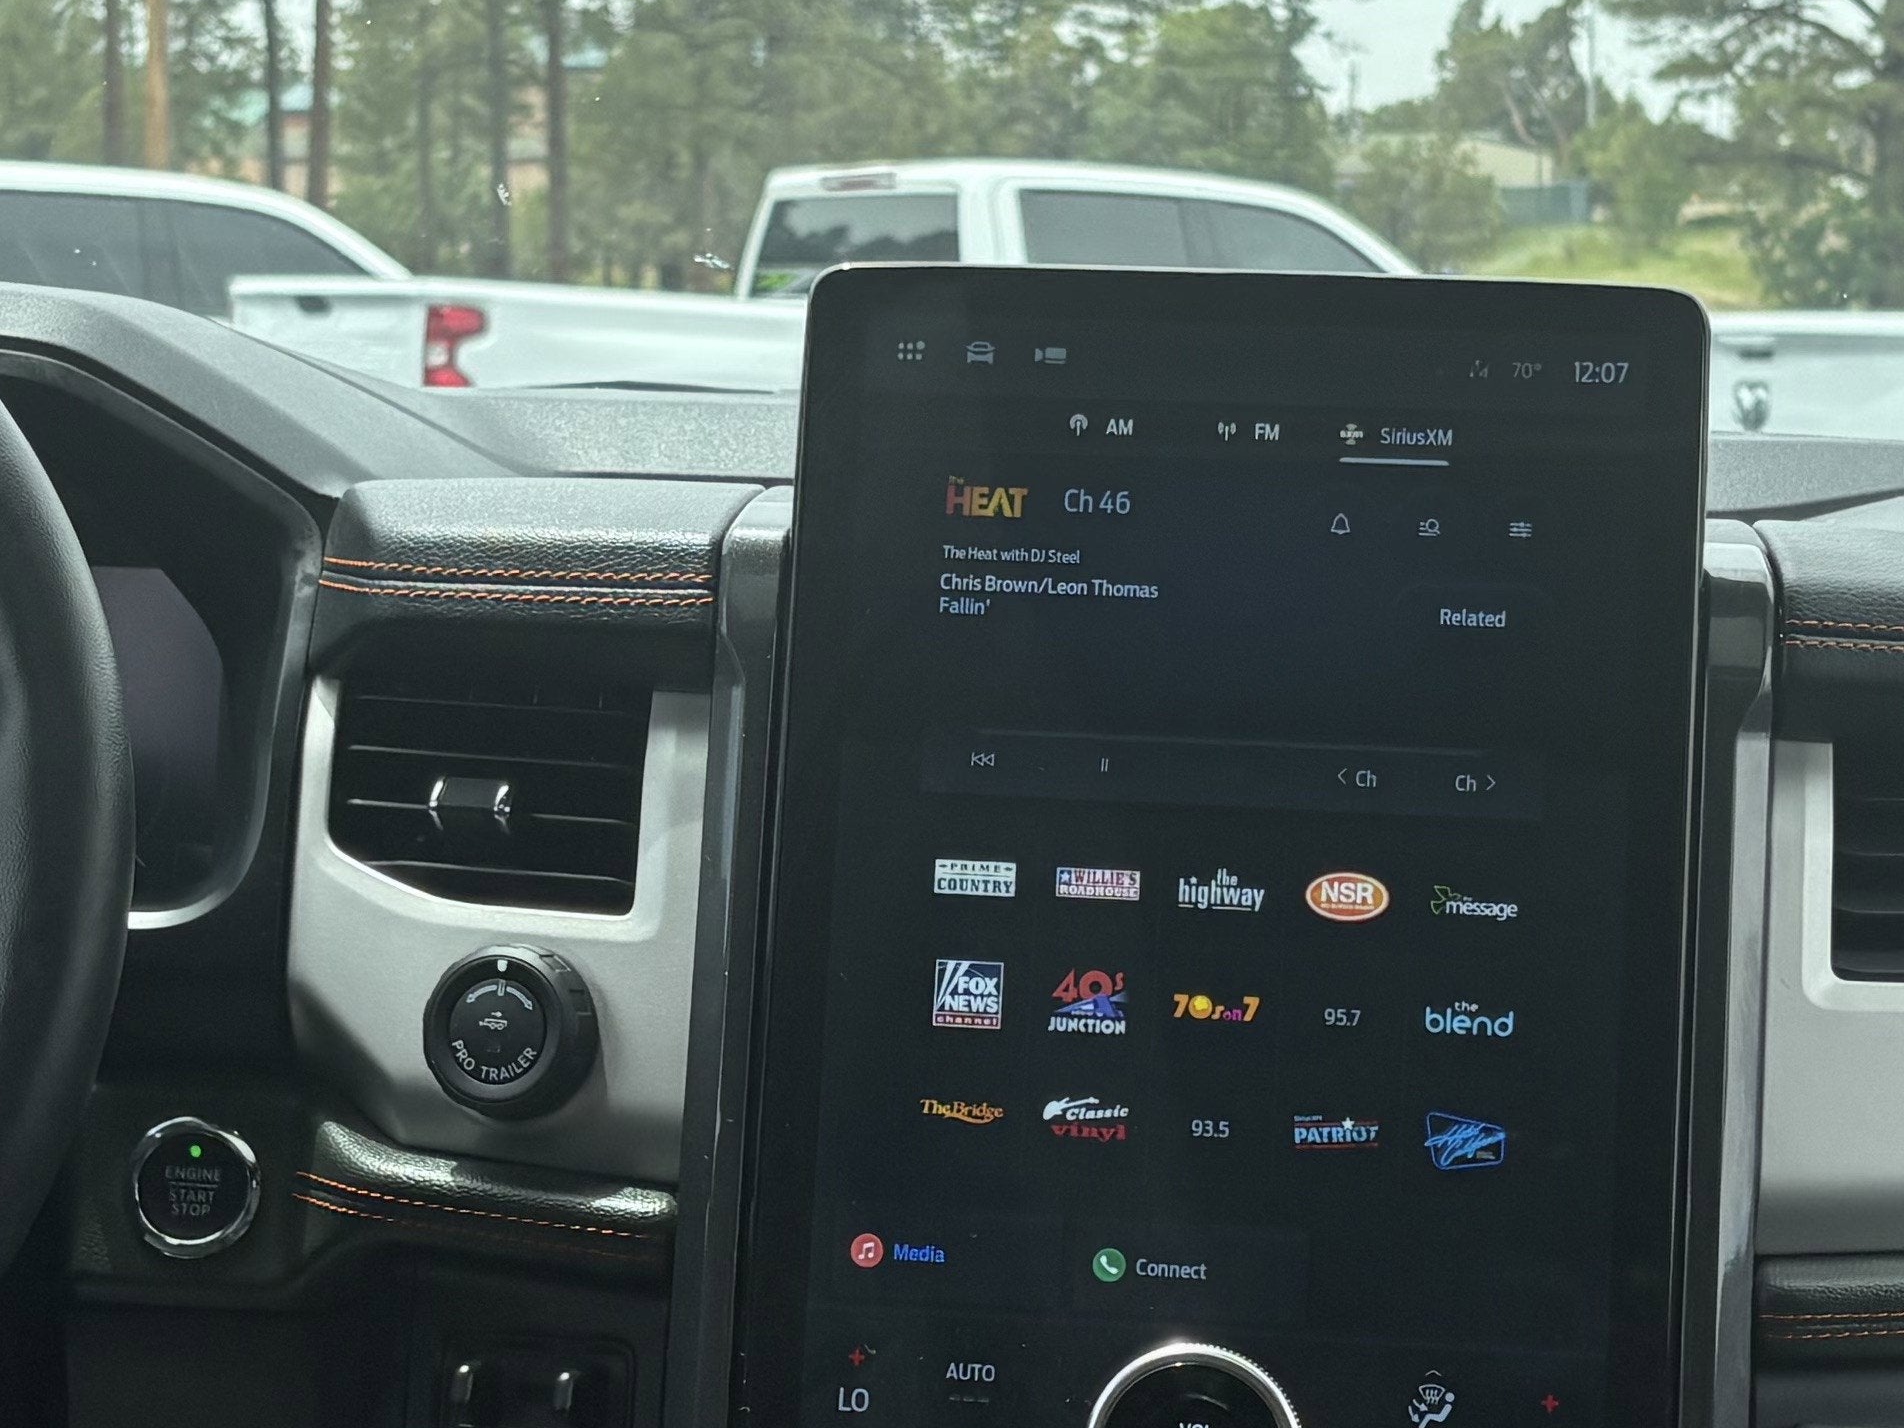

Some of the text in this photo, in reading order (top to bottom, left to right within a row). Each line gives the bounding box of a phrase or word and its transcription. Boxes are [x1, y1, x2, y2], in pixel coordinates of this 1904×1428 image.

[1573, 360, 1630, 384] 12:07
[1105, 418, 1134, 436] AM
[1254, 422, 1280, 442] FM
[1380, 427, 1454, 448] SiriusXM
[946, 484, 1029, 518] HEAT
[1063, 488, 1132, 515] Ch 46
[943, 545, 1081, 565] The Heat with DJ Steel
[940, 572, 1160, 599] Chris Brown/Leon Thomas
[939, 596, 991, 616] Fallin'
[1438, 607, 1507, 630] Related
[1355, 769, 1378, 788] Ch
[1454, 774, 1477, 793] Ch
[950, 861, 1002, 873] PRIME
[936, 876, 1014, 895] COUNTRY
[1074, 868, 1138, 887] WILLIE'S
[1216, 868, 1239, 888] the
[1059, 884, 1140, 899] ROADHOUSE
[1177, 875, 1266, 912] highway
[1319, 880, 1375, 905] NSR
[1445, 899, 1518, 922] message
[956, 975, 999, 996] FOX
[944, 994, 999, 1014] NEWS
[1453, 1000, 1480, 1014] the
[936, 1015, 1000, 1028] channel
[1047, 1015, 1127, 1036] JUNCTION
[1323, 1007, 1362, 1028] 95.7
[1424, 1005, 1515, 1038] blend
[451, 1039, 538, 1082] PRO TRAILER
[920, 1098, 1004, 1122] The Bridge
[1065, 1104, 1130, 1122] Classic
[1050, 1122, 1127, 1144] vinyl
[1191, 1119, 1230, 1139] 93.5
[1294, 1125, 1380, 1145] PATRIOT
[164, 1164, 223, 1183] ENGINE
[168, 1186, 215, 1204] START
[170, 1202, 212, 1217] STOP
[893, 1243, 946, 1264] Media
[1135, 1258, 1208, 1281] Connect
[945, 1362, 997, 1383] AUTO
[837, 1386, 871, 1413] LO
